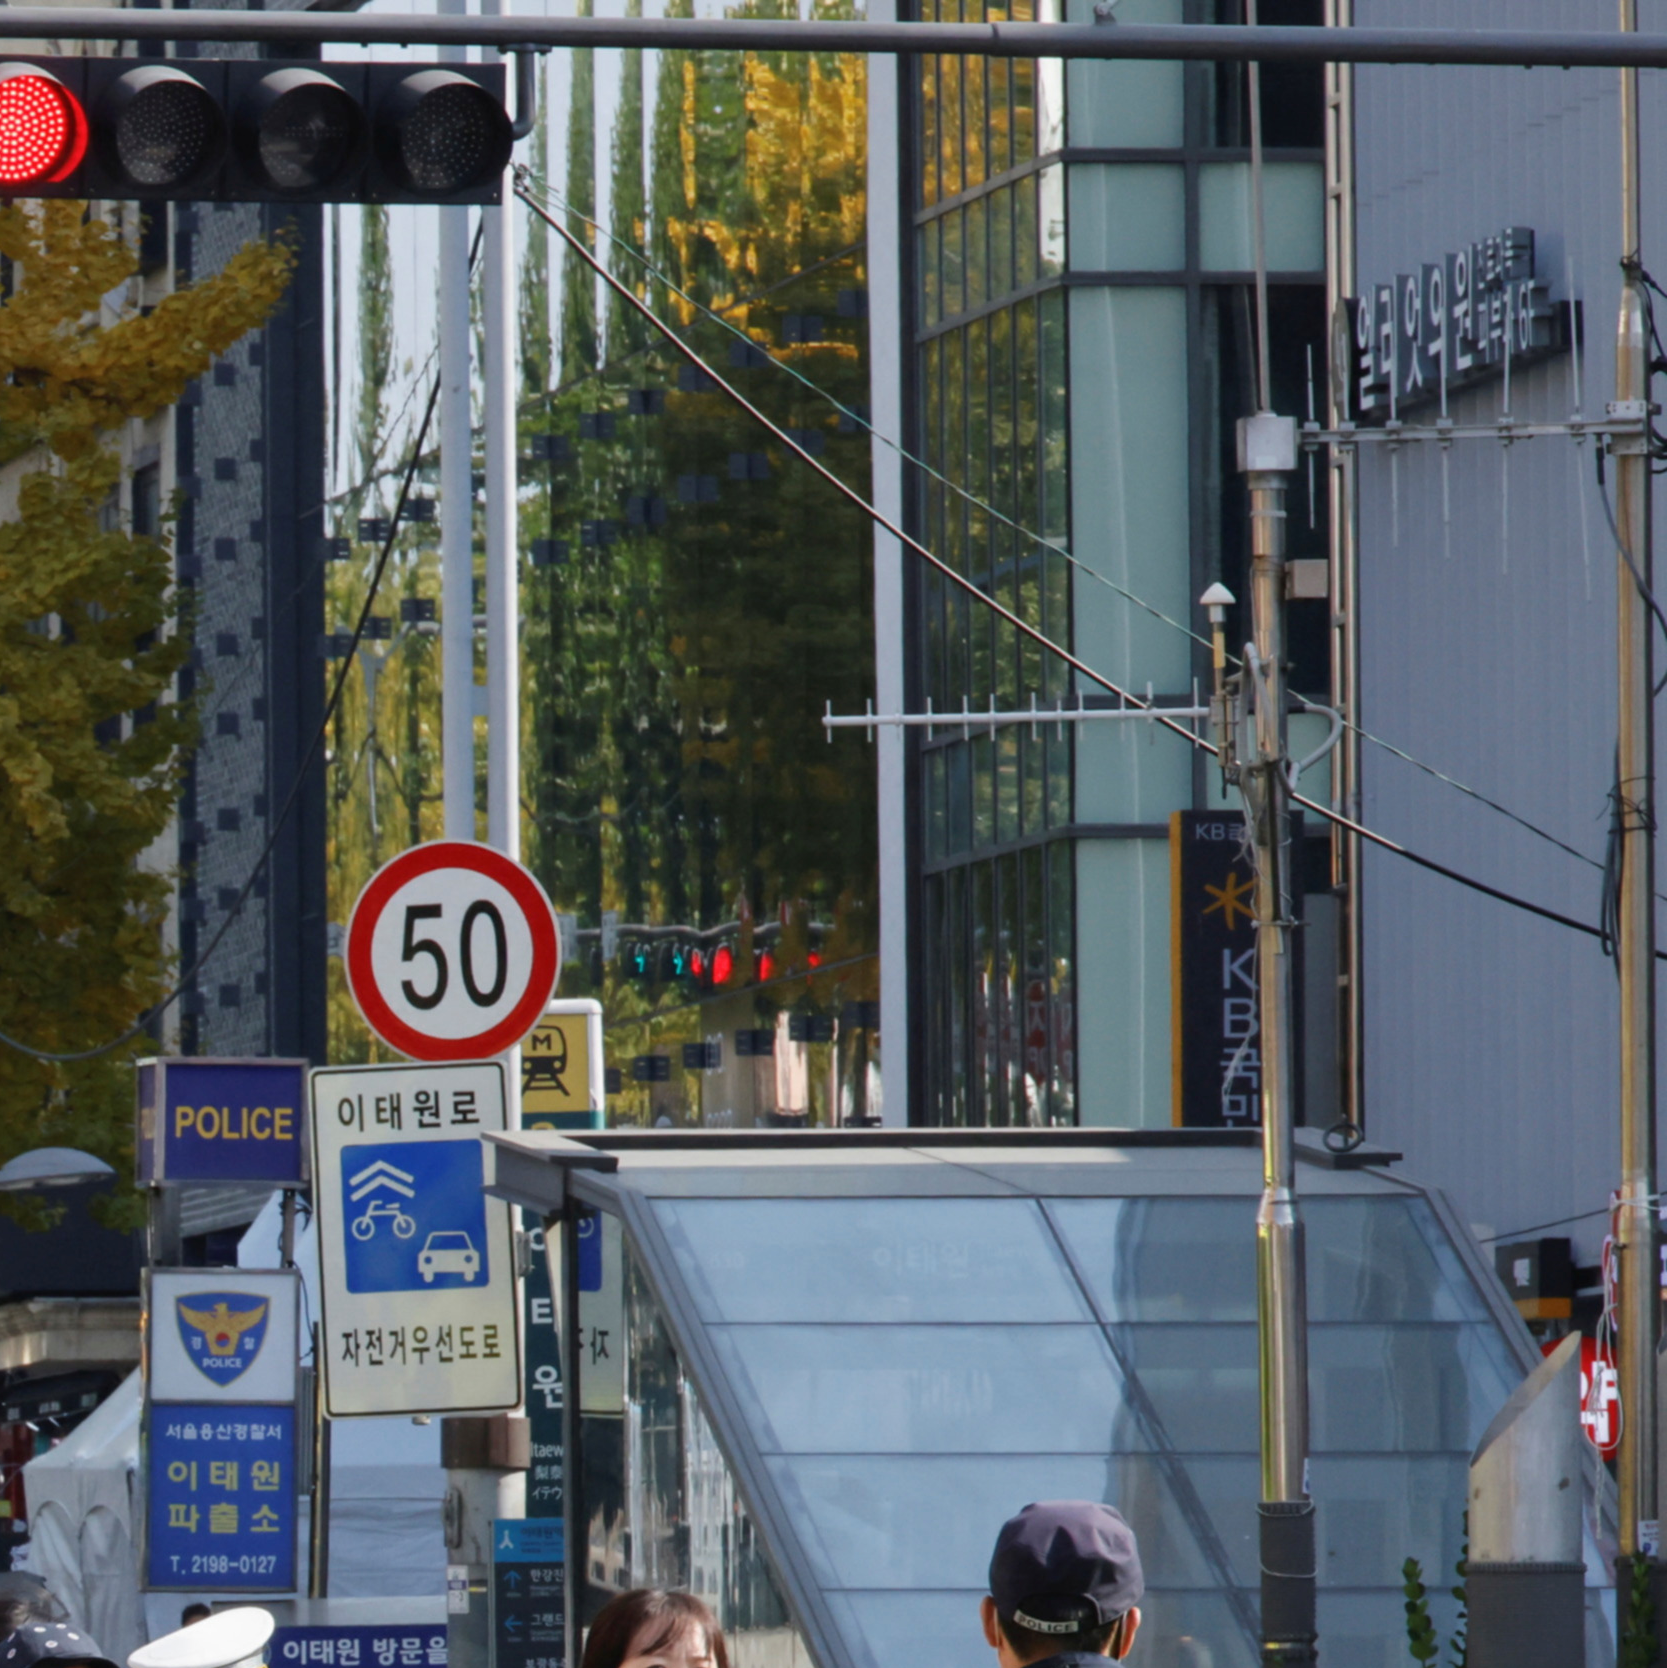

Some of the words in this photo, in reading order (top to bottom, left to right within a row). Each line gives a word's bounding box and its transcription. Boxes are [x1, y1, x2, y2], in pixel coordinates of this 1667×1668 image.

[401, 899, 508, 1011] 50
[175, 1105, 294, 1140] POLICE
[337, 1089, 481, 1133] 이태원로
[341, 1323, 502, 1368] 자전거우선도로
[202, 1357, 243, 1368] POLICE
[165, 1423, 282, 1441] 서울용산경찰서
[167, 1460, 281, 1491] 이태원
[168, 1502, 280, 1534] 파출소
[170, 1555, 186, 1576] T.
[192, 1555, 277, 1574] 2198-0127
[282, 1638, 361, 1667] 이태원
[372, 1636, 448, 1667] 방문을
